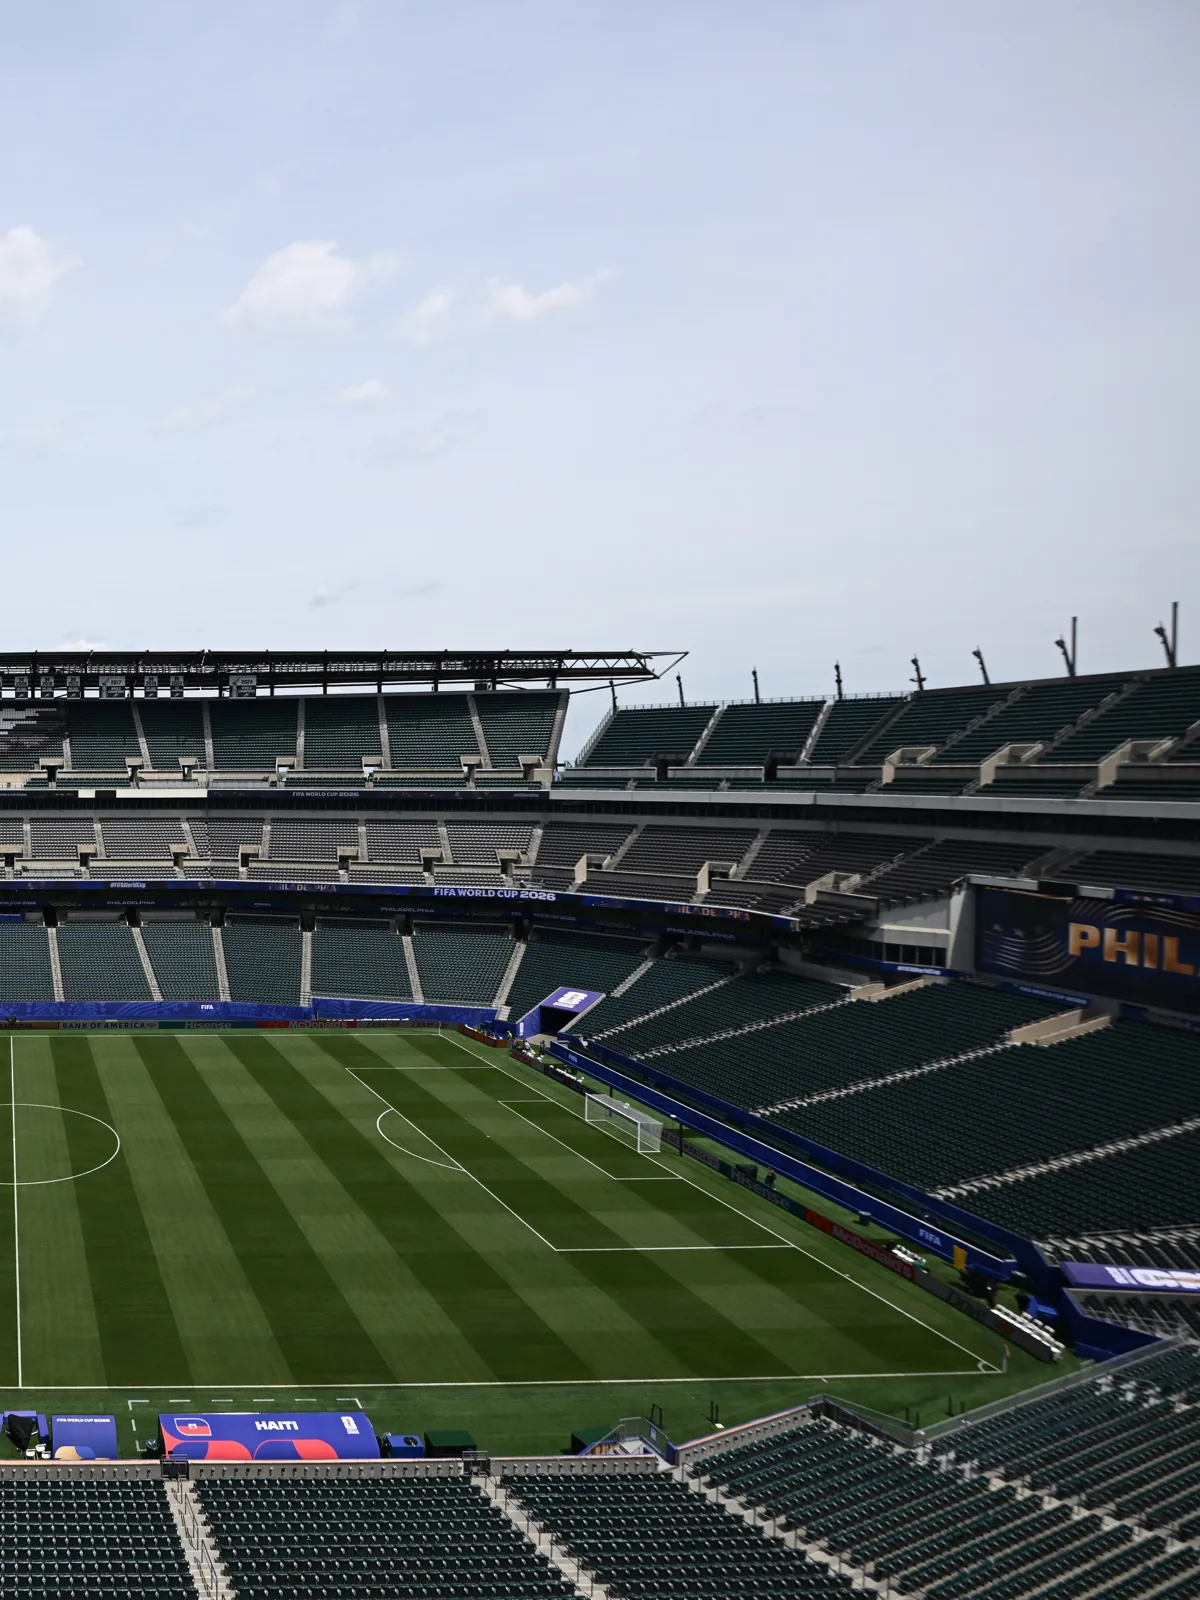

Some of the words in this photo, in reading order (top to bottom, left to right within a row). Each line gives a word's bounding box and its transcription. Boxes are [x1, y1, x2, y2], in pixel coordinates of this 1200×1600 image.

[434, 888, 457, 896] FIFA
[458, 889, 496, 898] WORLD
[497, 889, 519, 899] CUP
[520, 890, 556, 901] 2026
[666, 927, 736, 941] PHILADELPHIA
[1068, 922, 1200, 976] PHIL
[184, 1021, 232, 1029] Hisense
[288, 1020, 348, 1028] McDonald's
[732, 1167, 790, 1210] Hisense
[918, 1228, 942, 1246] FIFA
[255, 1420, 299, 1431] HAITI
